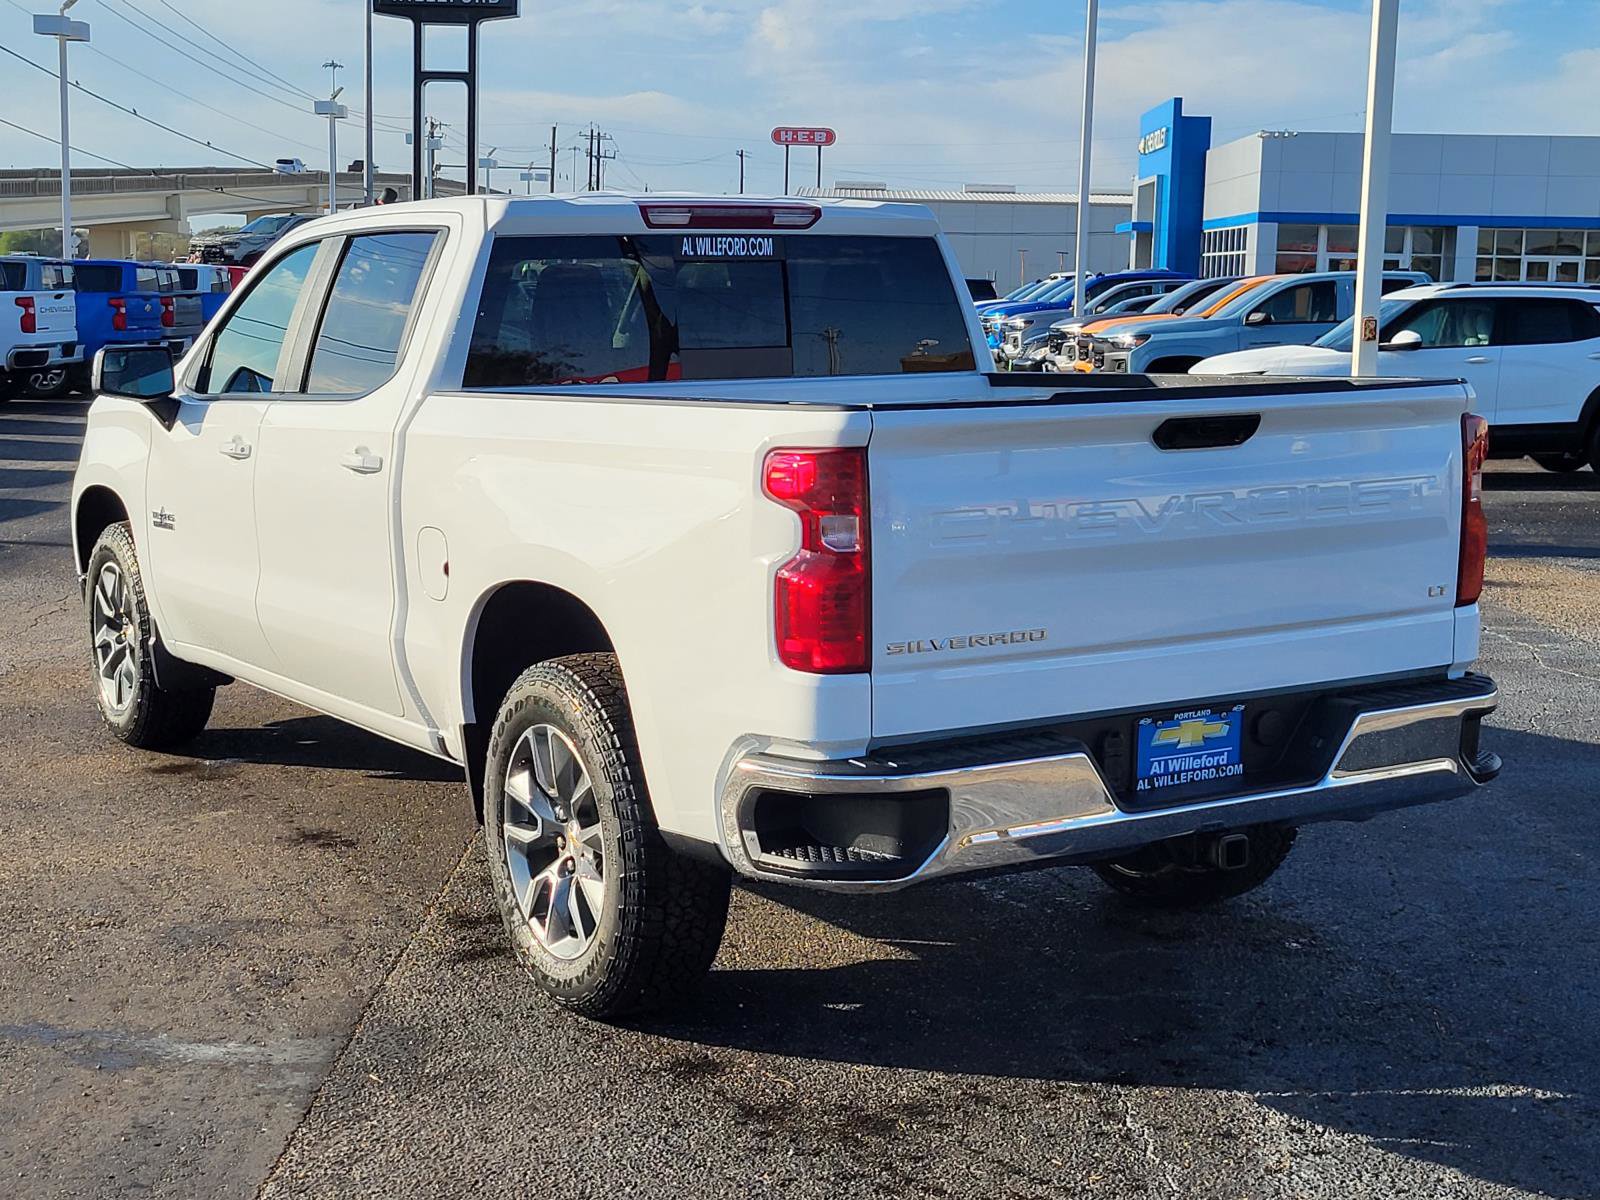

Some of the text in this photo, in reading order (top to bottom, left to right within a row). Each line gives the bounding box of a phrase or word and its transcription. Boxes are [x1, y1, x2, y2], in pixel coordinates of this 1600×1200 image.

[682, 237, 773, 256] AL WILLEFORD.COM
[929, 475, 1438, 548] CHEVROLET
[1428, 584, 1448, 598] LT
[886, 628, 1048, 655] SILVERADO
[1174, 709, 1211, 720] PORTLAND
[1150, 752, 1228, 775] Al Willeford
[1136, 763, 1243, 791] AL WILLEFORD.COM
